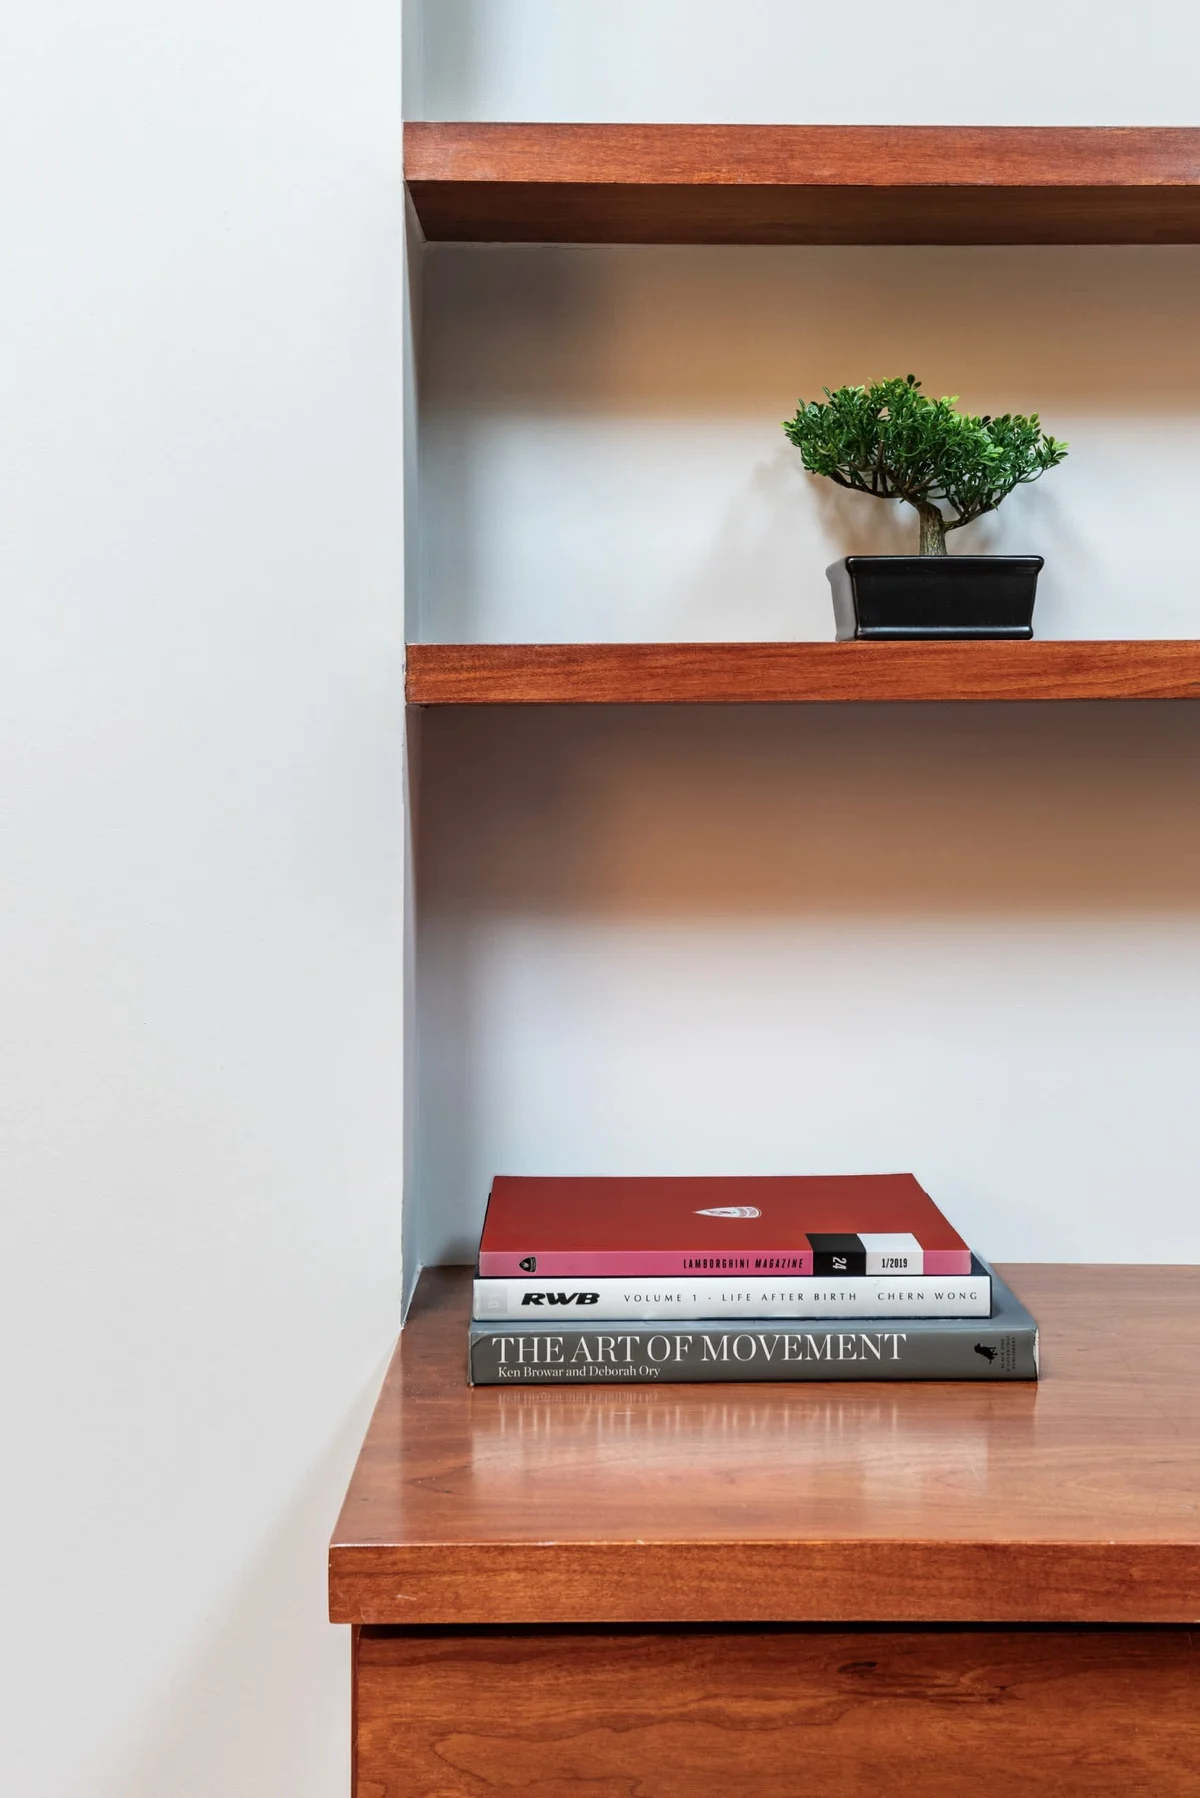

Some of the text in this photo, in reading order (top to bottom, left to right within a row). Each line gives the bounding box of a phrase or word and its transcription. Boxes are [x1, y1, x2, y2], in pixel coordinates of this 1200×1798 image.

[683, 1258, 804, 1269] LAMBORGHINI MAGAZINE
[832, 1256, 848, 1270] 24
[881, 1257, 908, 1269] 1/2019
[521, 1292, 600, 1306] RWB
[624, 1294, 682, 1303] VOLUME
[722, 1293, 752, 1302] LIFE
[761, 1293, 805, 1301] AFTER
[813, 1292, 857, 1301] BIRTH
[877, 1291, 978, 1301] CHERN WONG
[492, 1334, 907, 1363] THE ART OF MOVEMENT
[498, 1365, 661, 1379] Ken Browar and Deborah Ory
